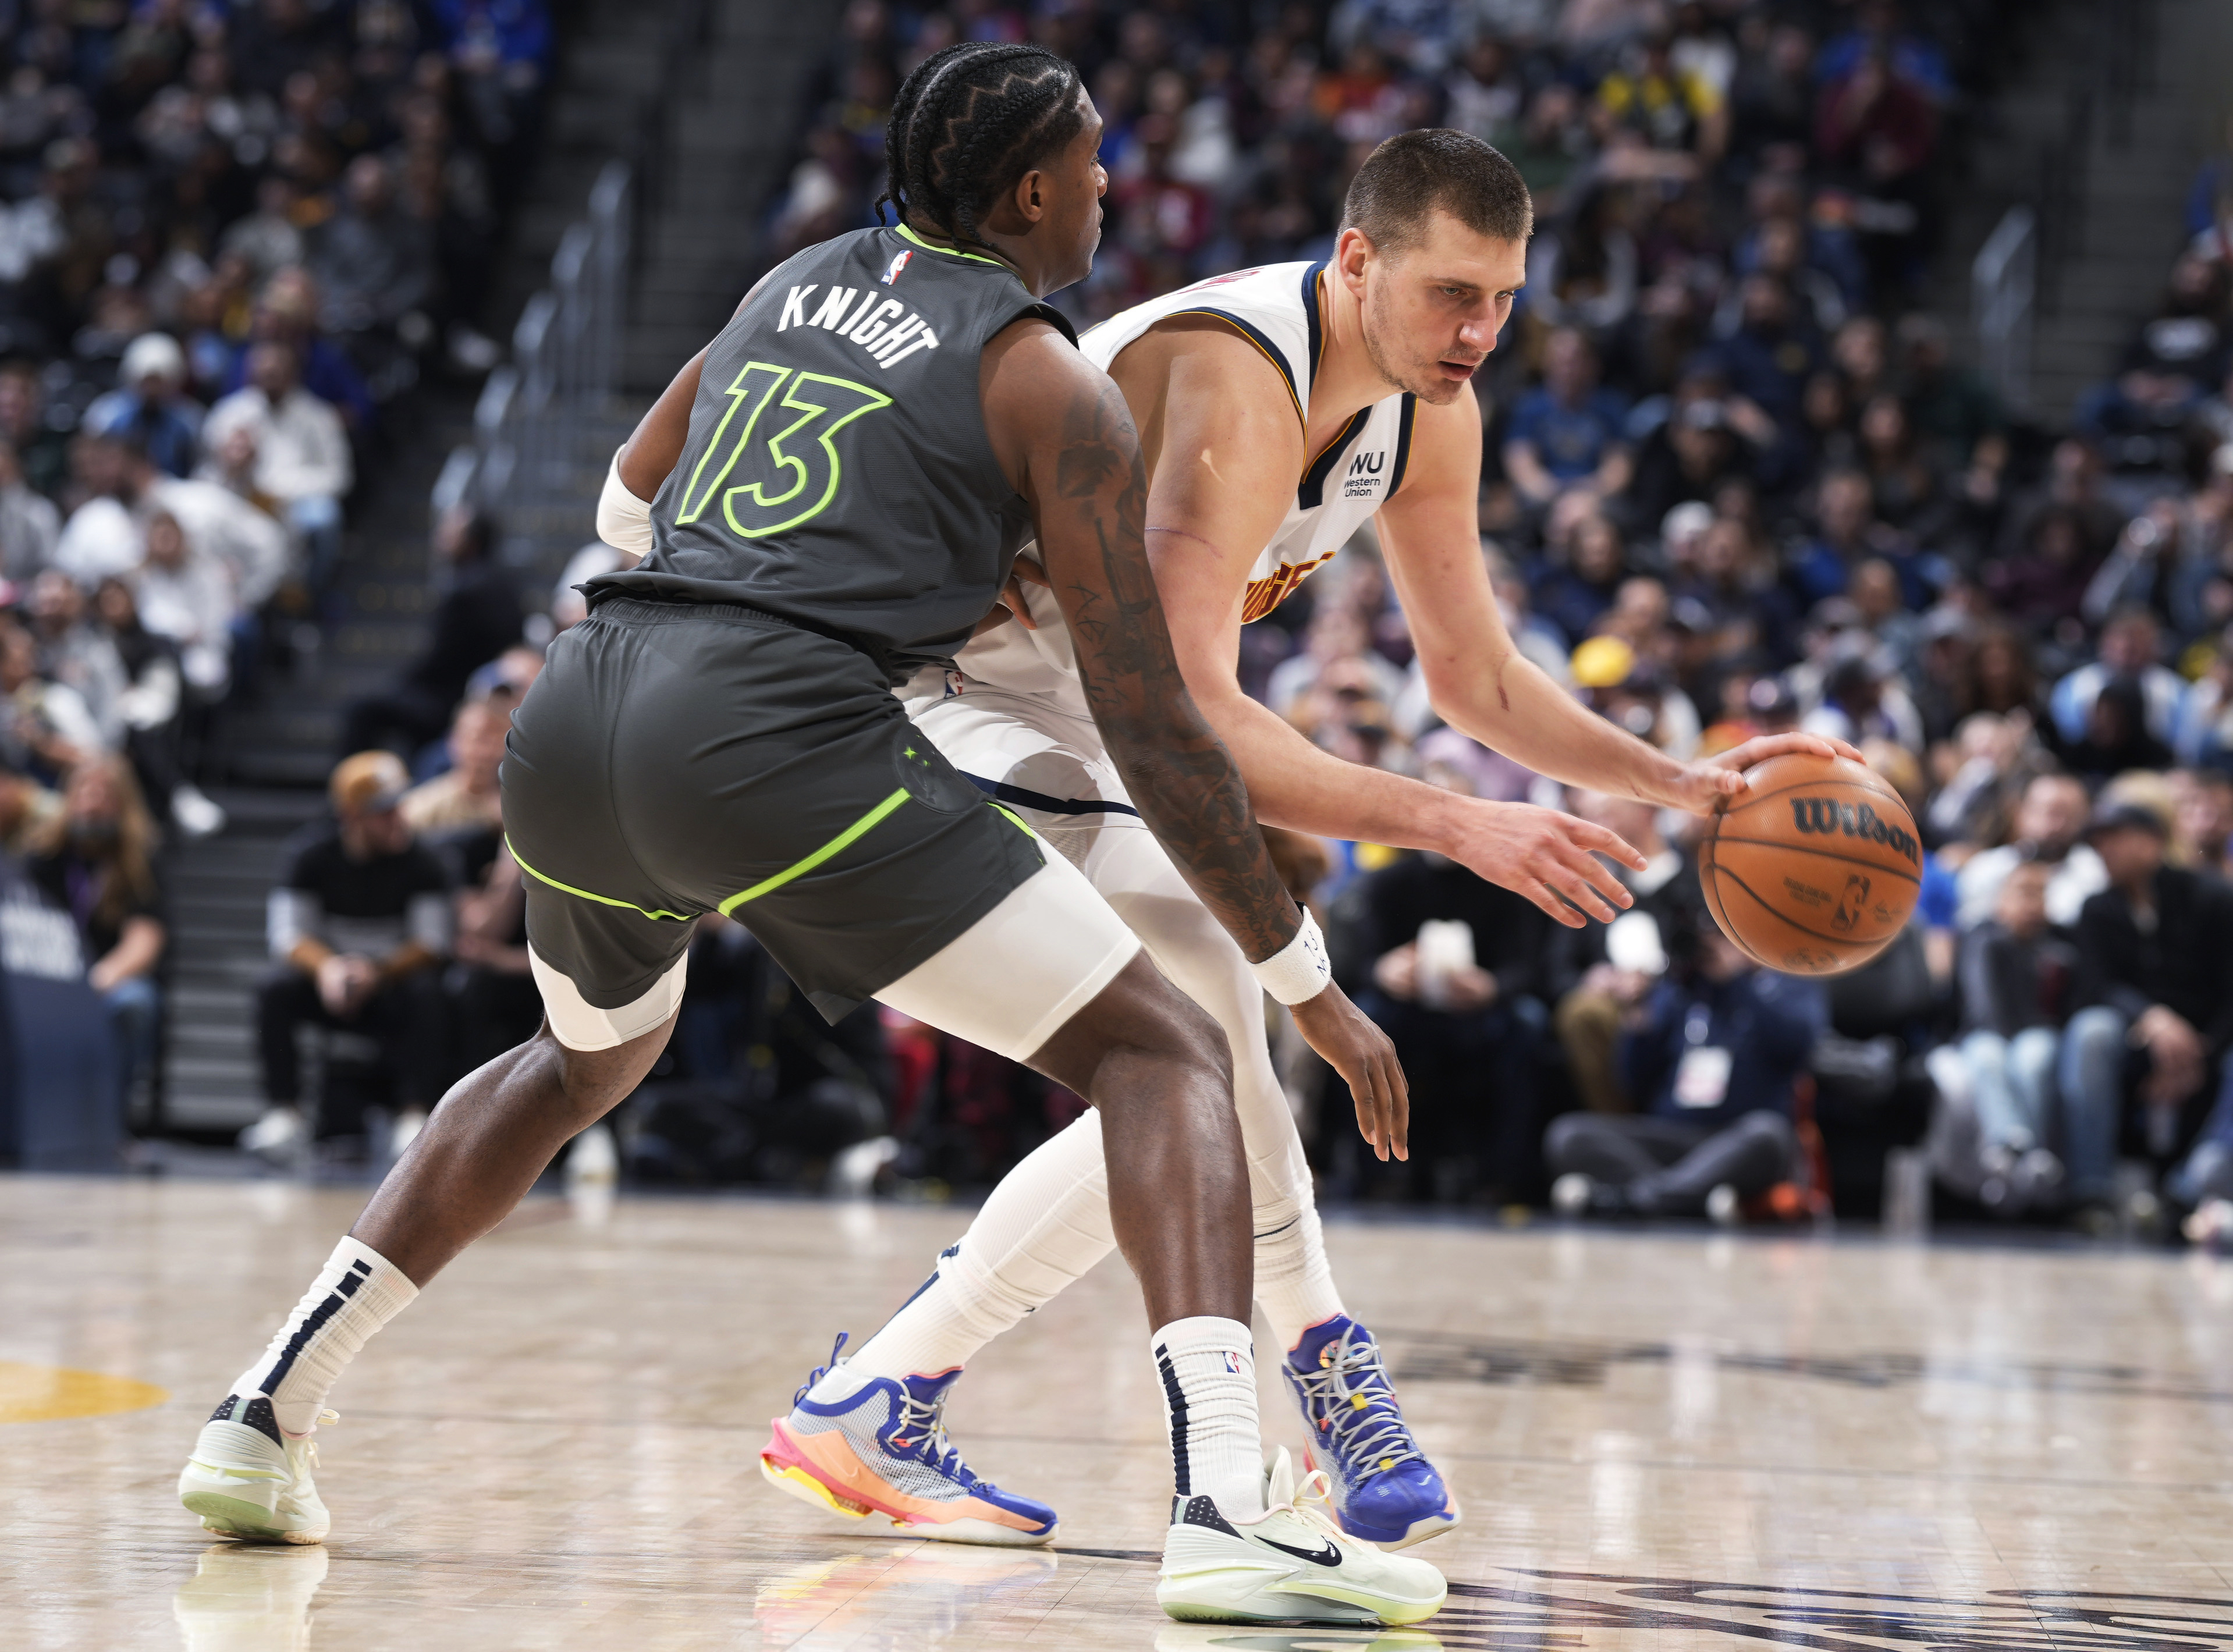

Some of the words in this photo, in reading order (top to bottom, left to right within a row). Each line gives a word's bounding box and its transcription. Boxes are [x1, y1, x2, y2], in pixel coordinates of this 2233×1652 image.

[777, 284, 940, 369] KNIGHT
[675, 361, 893, 538] 13
[1349, 452, 1384, 477] WU
[1344, 478, 1380, 489] Western
[1345, 487, 1372, 497] Union
[1790, 797, 1918, 866] Wilson
